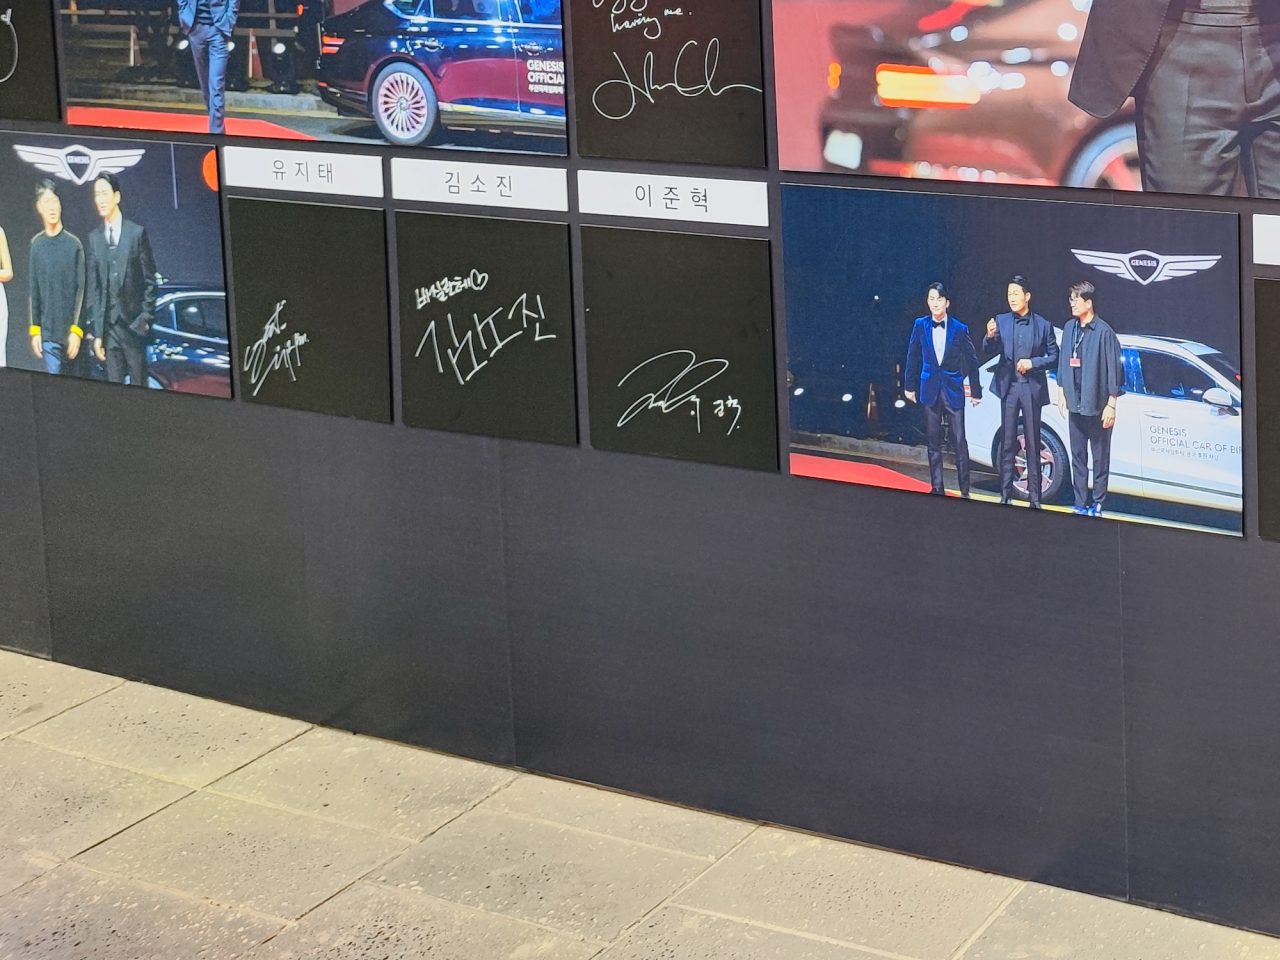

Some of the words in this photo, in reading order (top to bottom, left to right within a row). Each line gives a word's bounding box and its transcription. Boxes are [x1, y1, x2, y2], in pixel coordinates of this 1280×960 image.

[610, 12, 662, 40] having
[271, 159, 333, 184] 유지태
[444, 171, 513, 199] 김소진
[635, 184, 708, 213] 이준혁
[1149, 424, 1187, 438] GENESIS
[1150, 435, 1190, 449] OFFICIAL
[1192, 440, 1213, 452] CAR
[1214, 443, 1228, 453] OF
